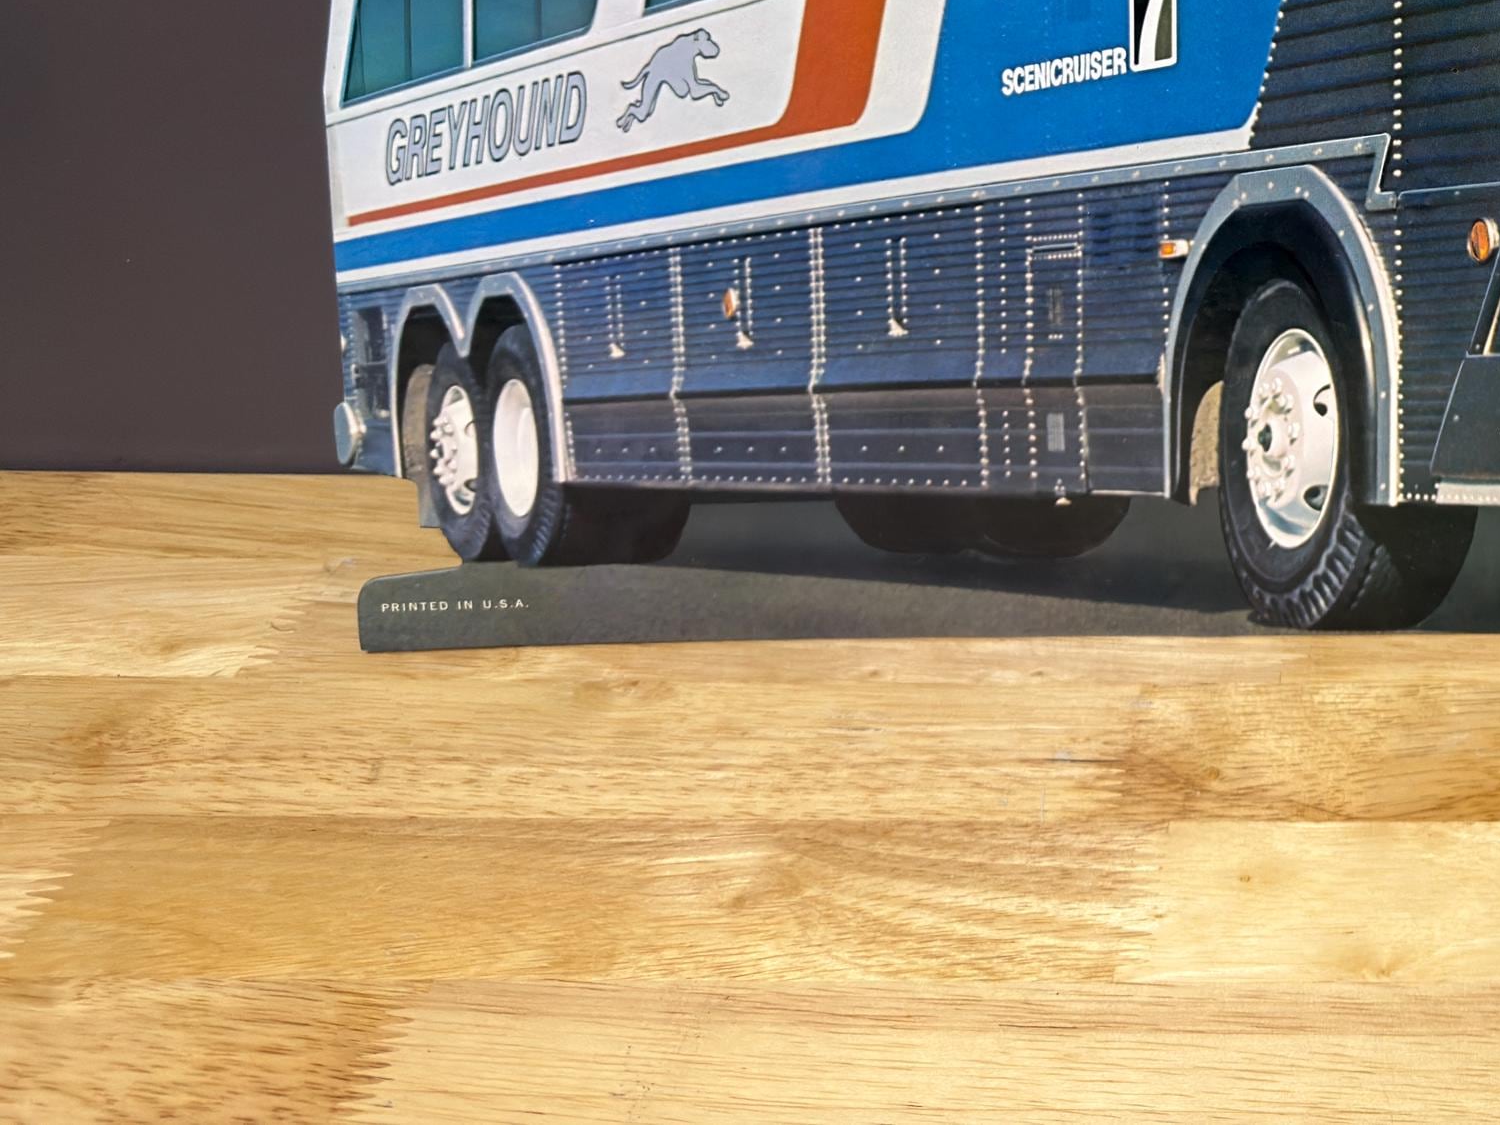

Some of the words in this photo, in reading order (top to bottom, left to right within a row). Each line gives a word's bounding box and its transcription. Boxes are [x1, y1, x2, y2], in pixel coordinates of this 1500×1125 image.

[1001, 46, 1127, 96] SCENICRUISER
[386, 71, 587, 186] GREYHOUND
[381, 602, 449, 613] PRINTED
[457, 600, 474, 611] IN
[482, 599, 529, 609] U.S.A.
